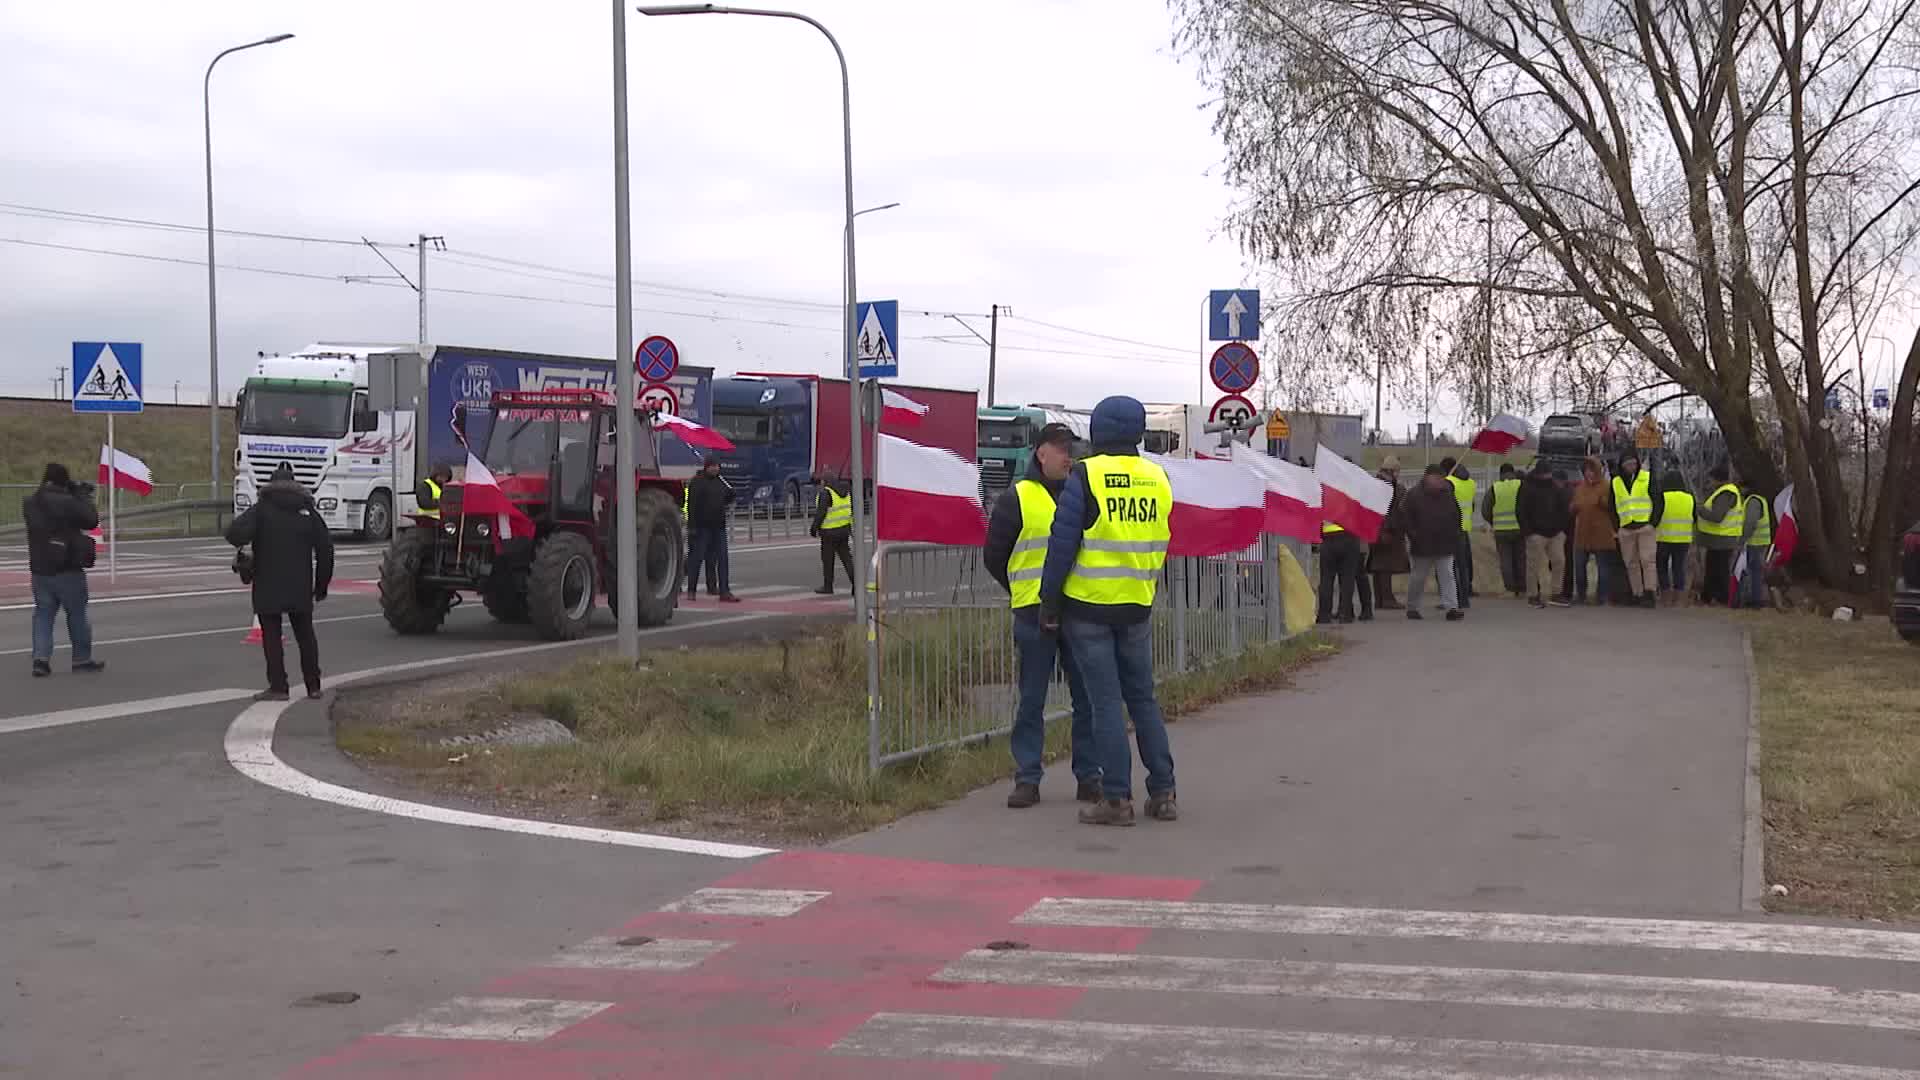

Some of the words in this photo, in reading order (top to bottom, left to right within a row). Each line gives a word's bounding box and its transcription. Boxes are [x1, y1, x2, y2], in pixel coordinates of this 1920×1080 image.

[466, 365, 489, 377] WEST
[462, 378, 492, 399] UKR
[508, 408, 579, 423] POLSKA
[1106, 475, 1129, 487] TPR
[1106, 497, 1157, 522] PRASA
